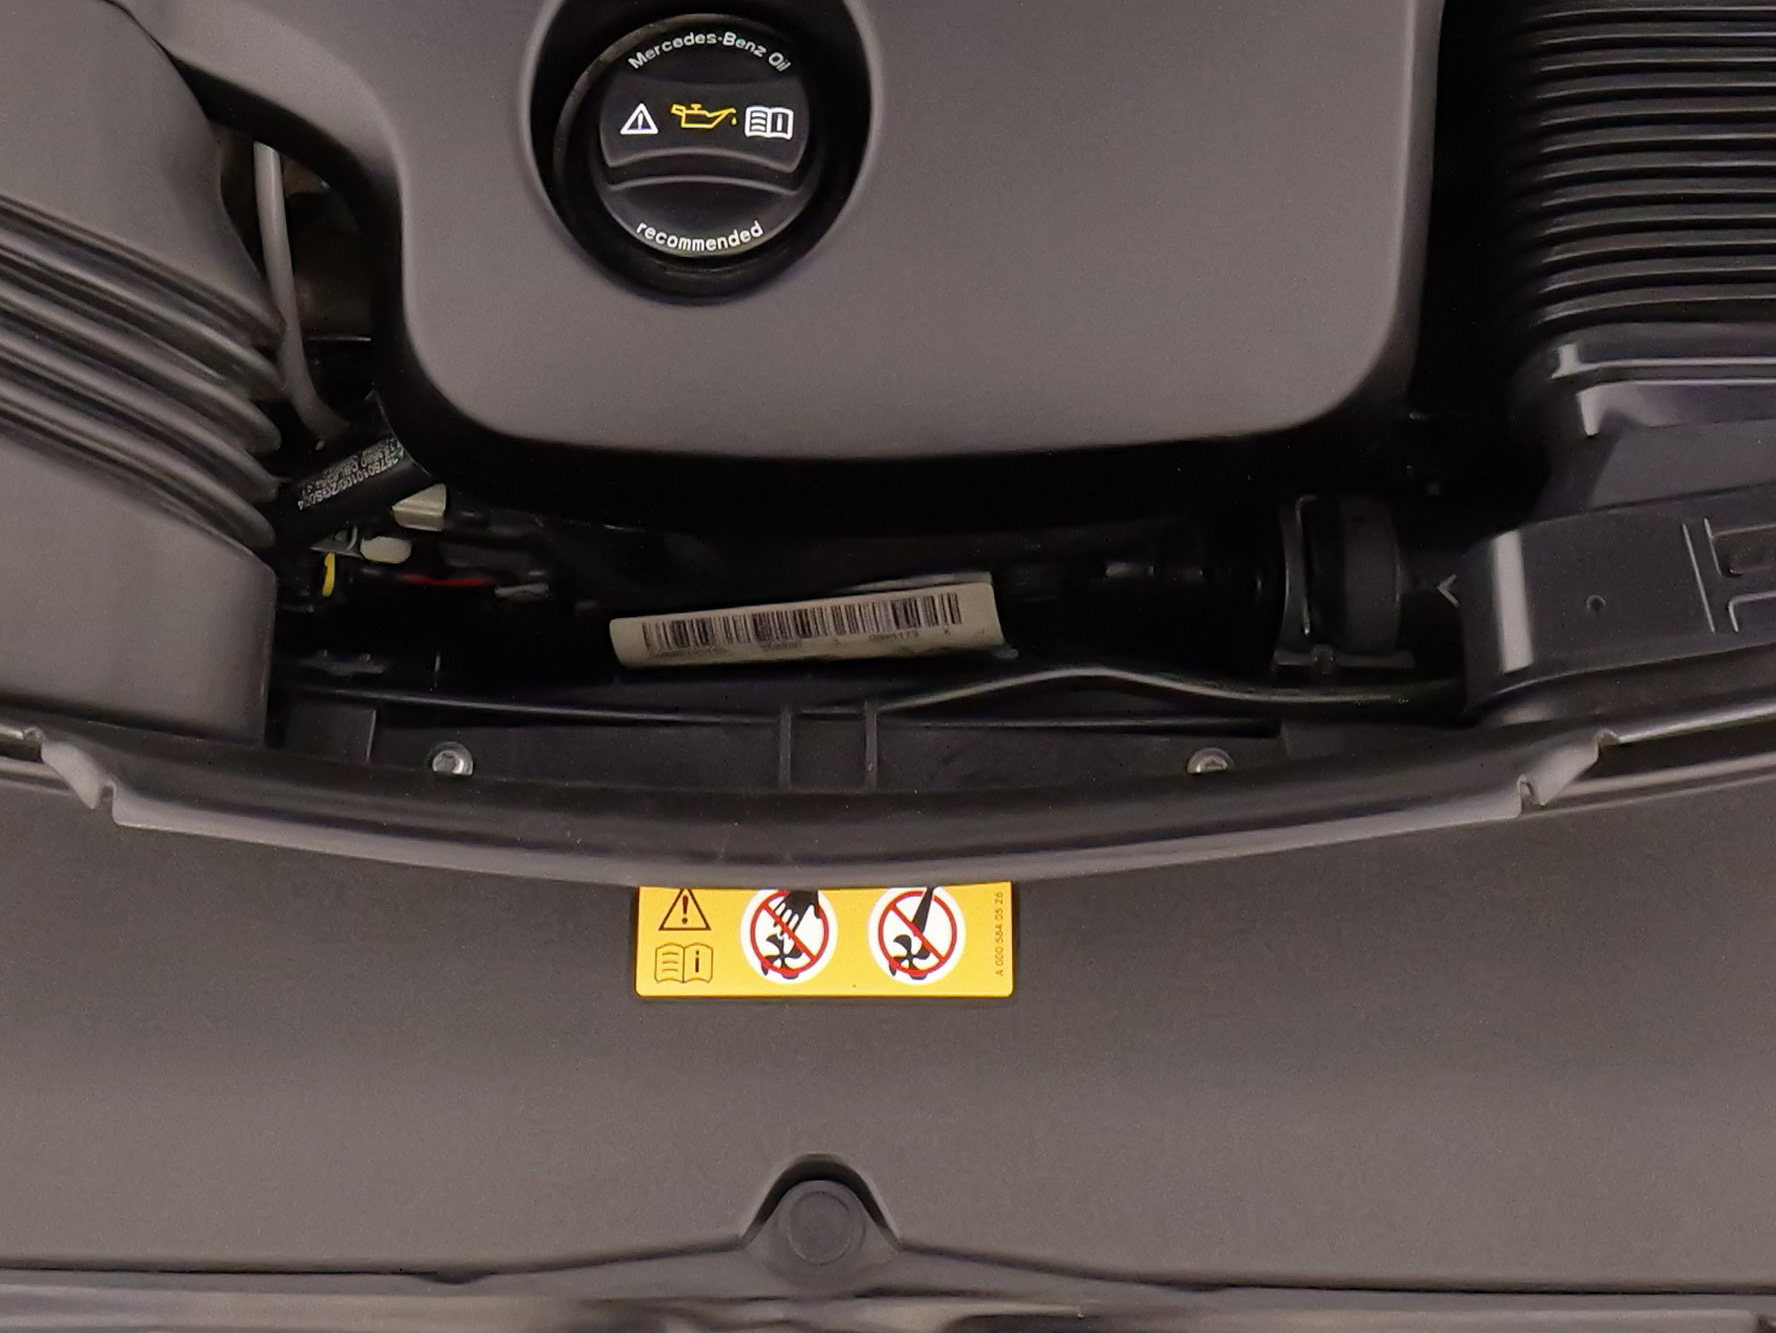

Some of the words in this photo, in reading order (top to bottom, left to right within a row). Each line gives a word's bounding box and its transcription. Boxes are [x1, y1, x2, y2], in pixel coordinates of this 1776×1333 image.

[627, 30, 767, 71] Mercedes-Benz
[768, 50, 793, 74] Oil
[635, 220, 765, 253] recommended
[994, 891, 1004, 905] 26
[994, 924, 1004, 944] 584
[994, 969, 1004, 977] A
